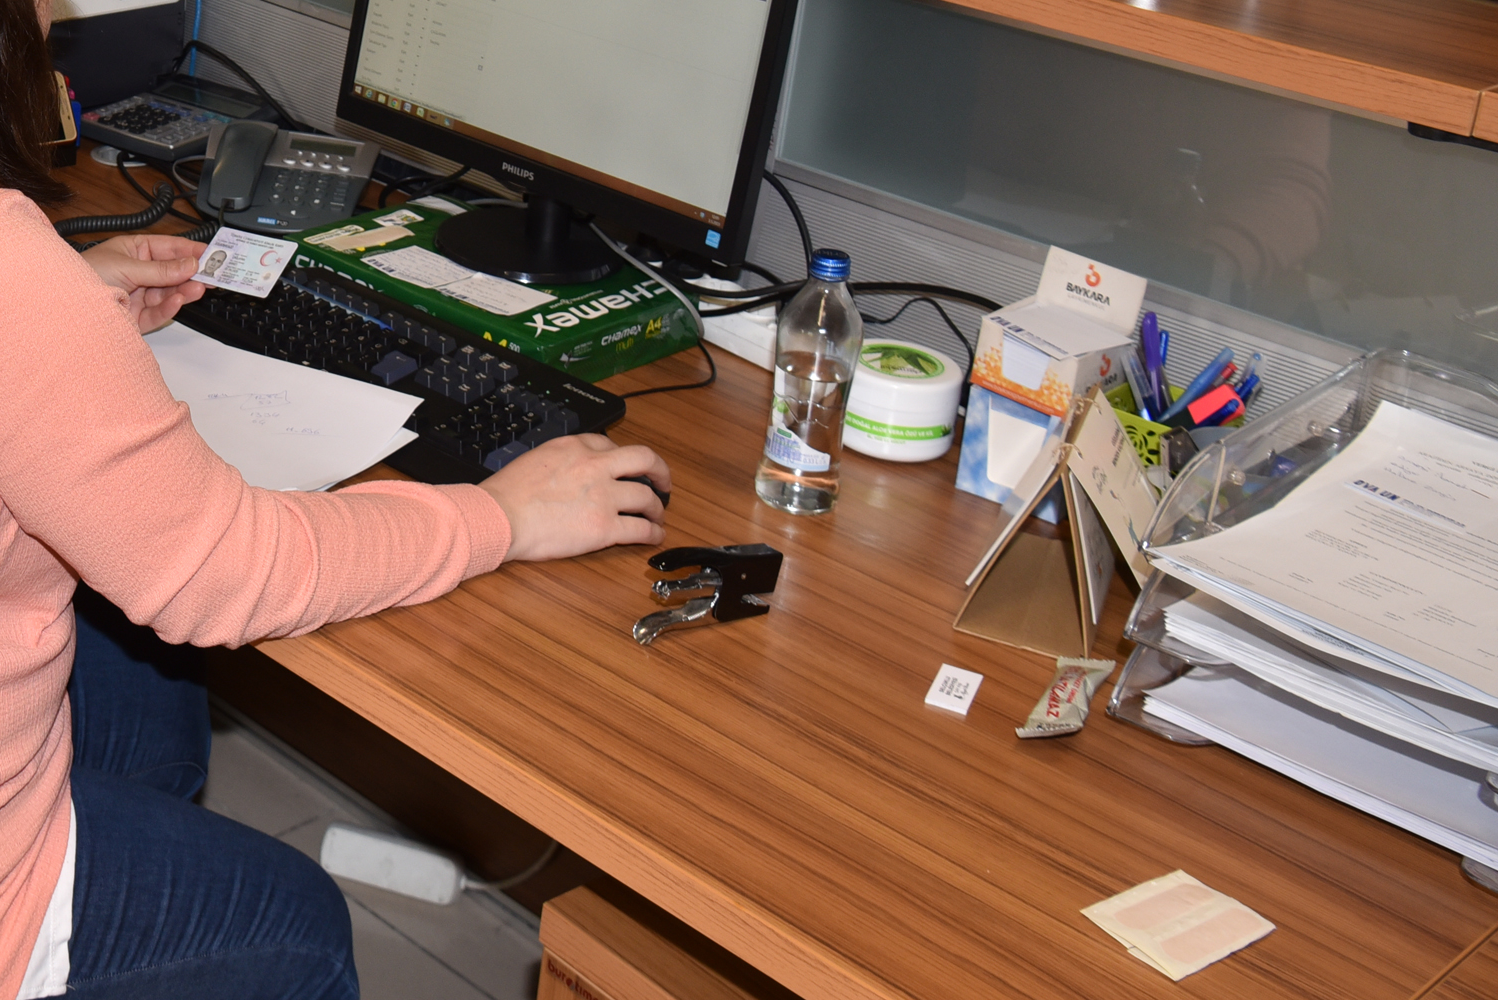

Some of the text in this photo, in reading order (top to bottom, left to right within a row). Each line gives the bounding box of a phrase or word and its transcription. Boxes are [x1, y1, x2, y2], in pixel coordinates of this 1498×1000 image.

[502, 161, 535, 181] PHILIPS
[1066, 282, 1110, 306] BAYKARA
[872, 424, 887, 434] ALOE
